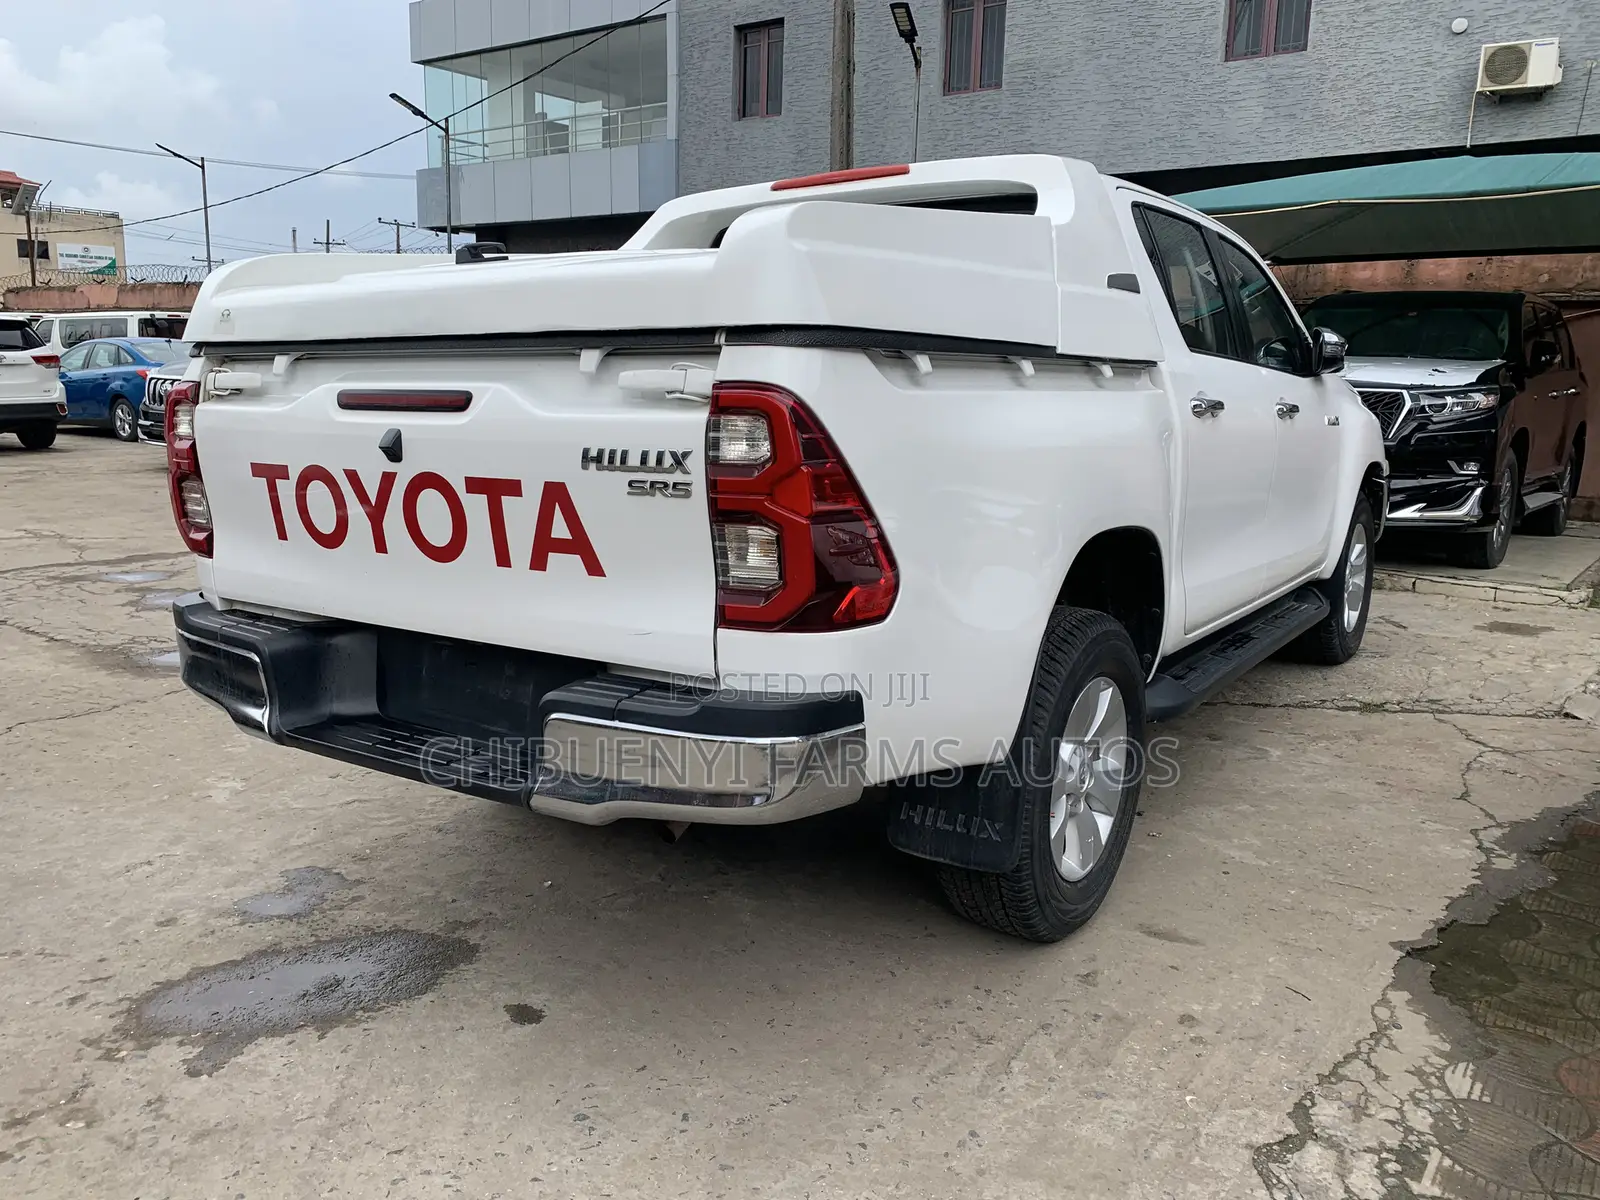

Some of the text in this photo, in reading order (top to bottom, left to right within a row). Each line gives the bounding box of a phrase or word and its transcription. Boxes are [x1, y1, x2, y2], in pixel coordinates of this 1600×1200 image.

[581, 447, 693, 474] HILUX
[626, 479, 693, 499] SR5
[250, 462, 607, 577] TOYOTA
[900, 801, 1004, 842] HILUX
